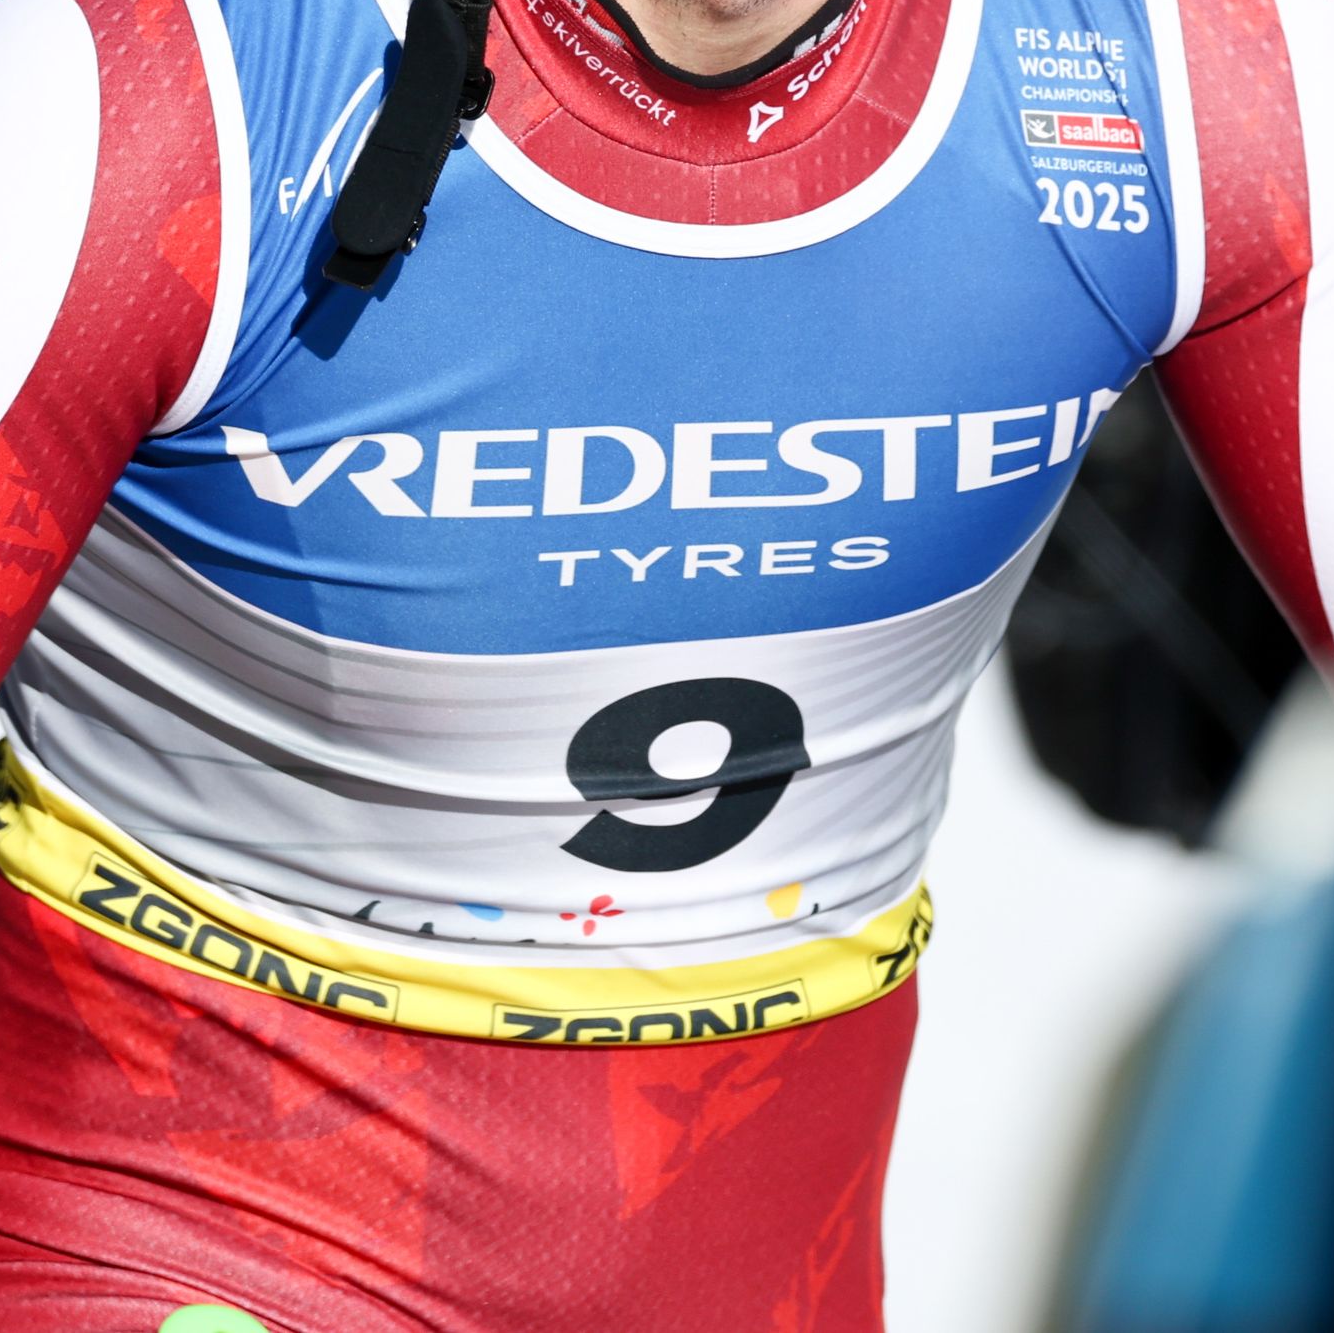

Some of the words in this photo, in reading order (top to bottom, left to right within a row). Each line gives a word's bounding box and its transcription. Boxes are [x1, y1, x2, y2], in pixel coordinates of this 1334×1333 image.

[1015, 27, 1051, 51] FIS
[1018, 55, 1103, 81] WORLD
[1030, 155, 1149, 177] SALZBURGERLAND
[1034, 177, 1150, 235] 2025
[537, 534, 891, 587] TYRES
[558, 676, 813, 874] 9
